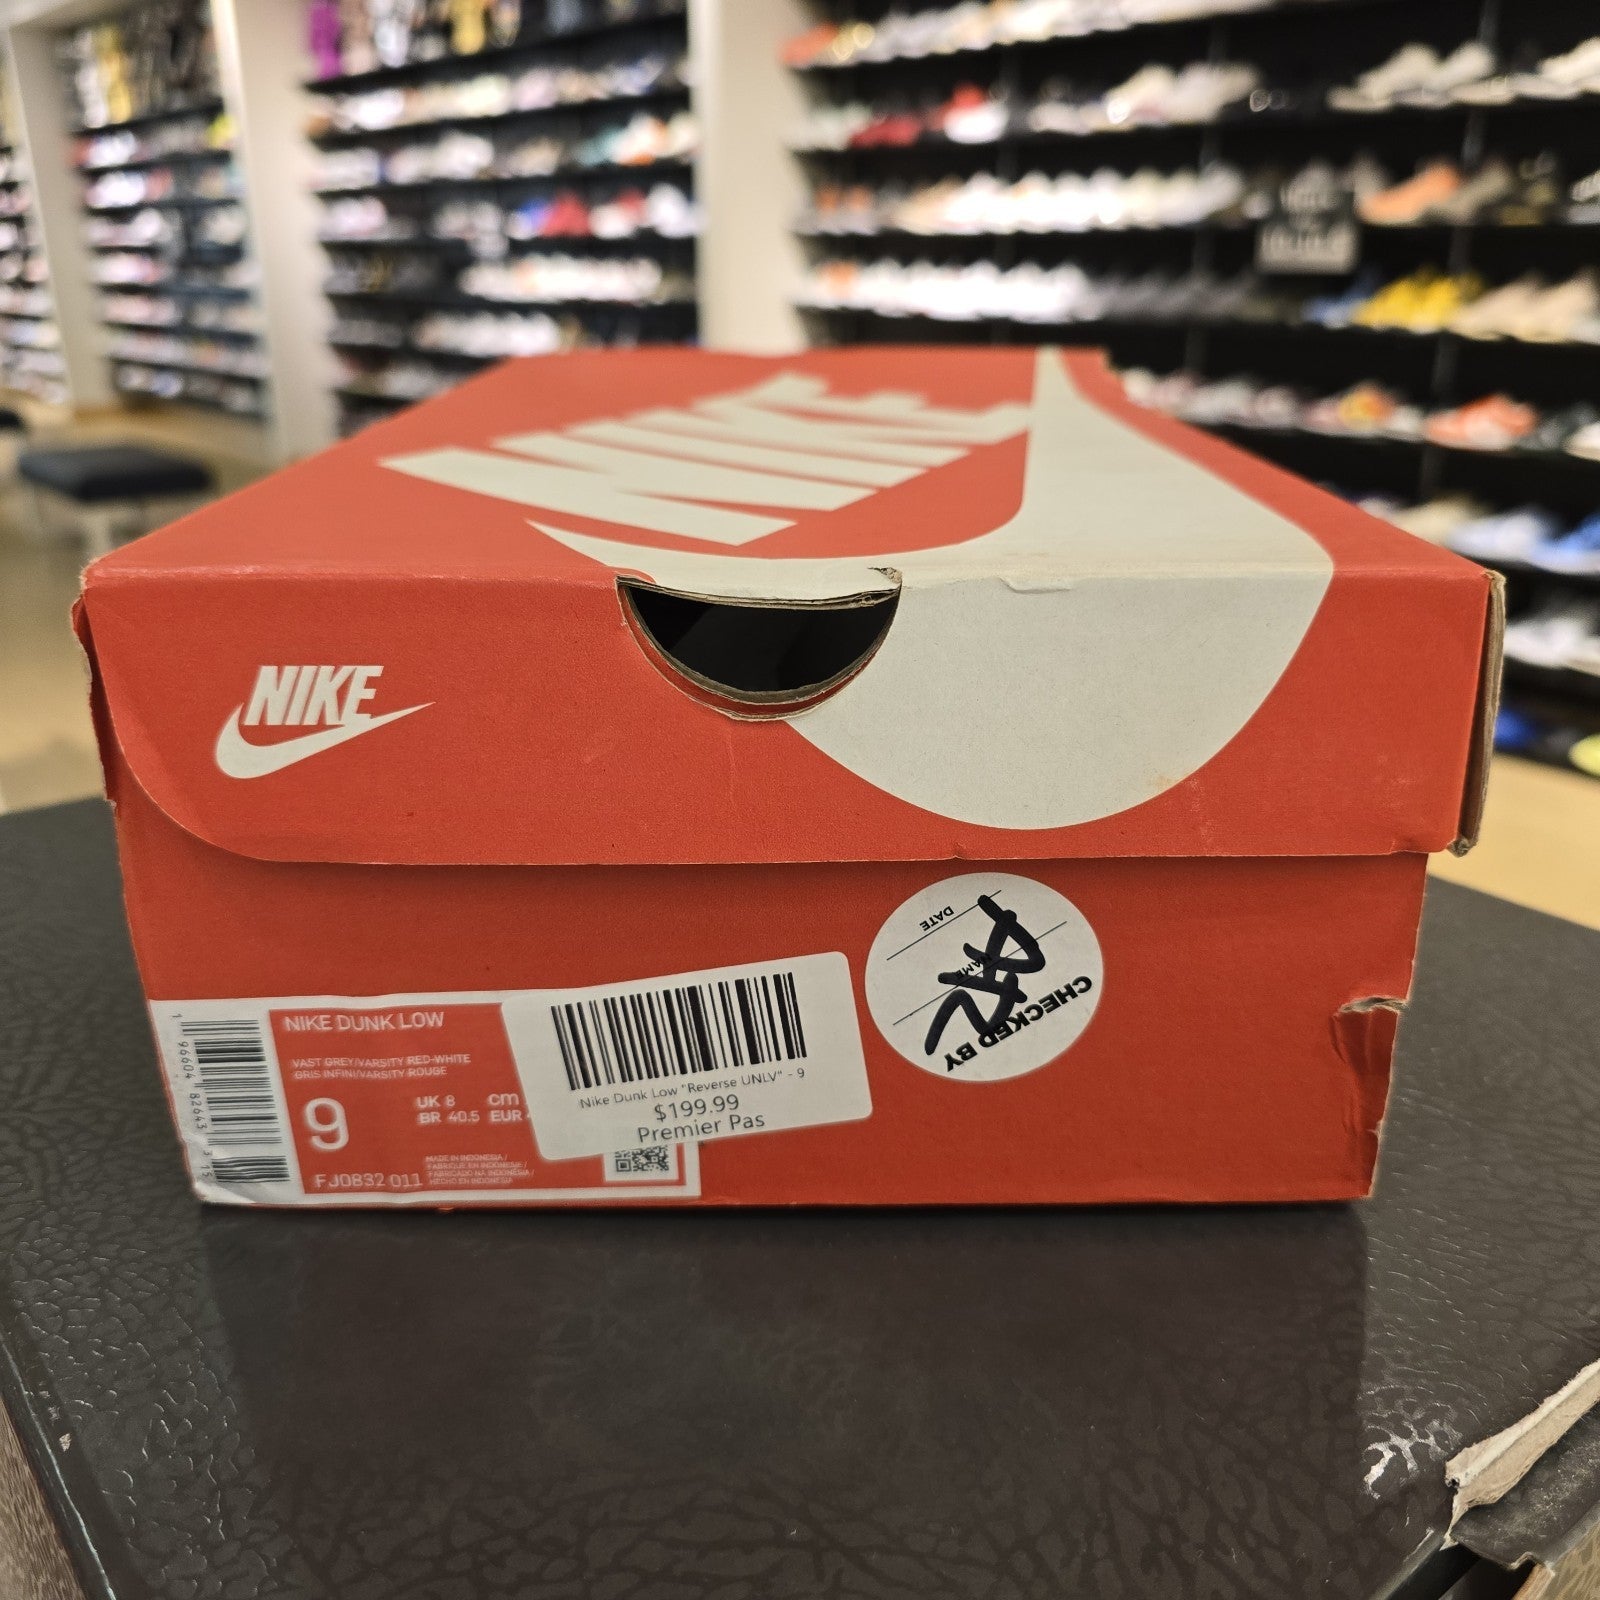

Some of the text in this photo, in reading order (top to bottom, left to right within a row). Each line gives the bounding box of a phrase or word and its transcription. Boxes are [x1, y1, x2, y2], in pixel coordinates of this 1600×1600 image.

[376, 371, 1030, 547] NIKE
[243, 665, 385, 726] NIKE
[919, 905, 955, 932] DATE
[284, 1011, 444, 1032] NIKE DUNK LOW
[944, 975, 1093, 1073] CHECKED BY
[292, 1053, 471, 1068] VAST GREY/VARSITY RED-WHITE
[294, 1066, 447, 1080] GRIS INFINI/VARSITY ROUGE
[178, 1041, 196, 1079] 96604
[189, 1092, 208, 1130] 82643
[579, 1095, 610, 1109] Nike
[614, 1091, 648, 1104] Dunk
[652, 1086, 678, 1099] Low
[681, 1078, 737, 1093] "Reverse
[741, 1069, 783, 1086] UNLV"
[798, 1067, 805, 1079] 9
[416, 1094, 456, 1109] UK 8
[487, 1093, 520, 1106] cm
[654, 1093, 740, 1123] $199.99
[304, 1097, 350, 1151] 9
[418, 1110, 480, 1124] BR 40.5
[489, 1109, 523, 1122] EUR
[637, 1113, 766, 1144] Premier Pas
[389, 1173, 423, 1188] 011
